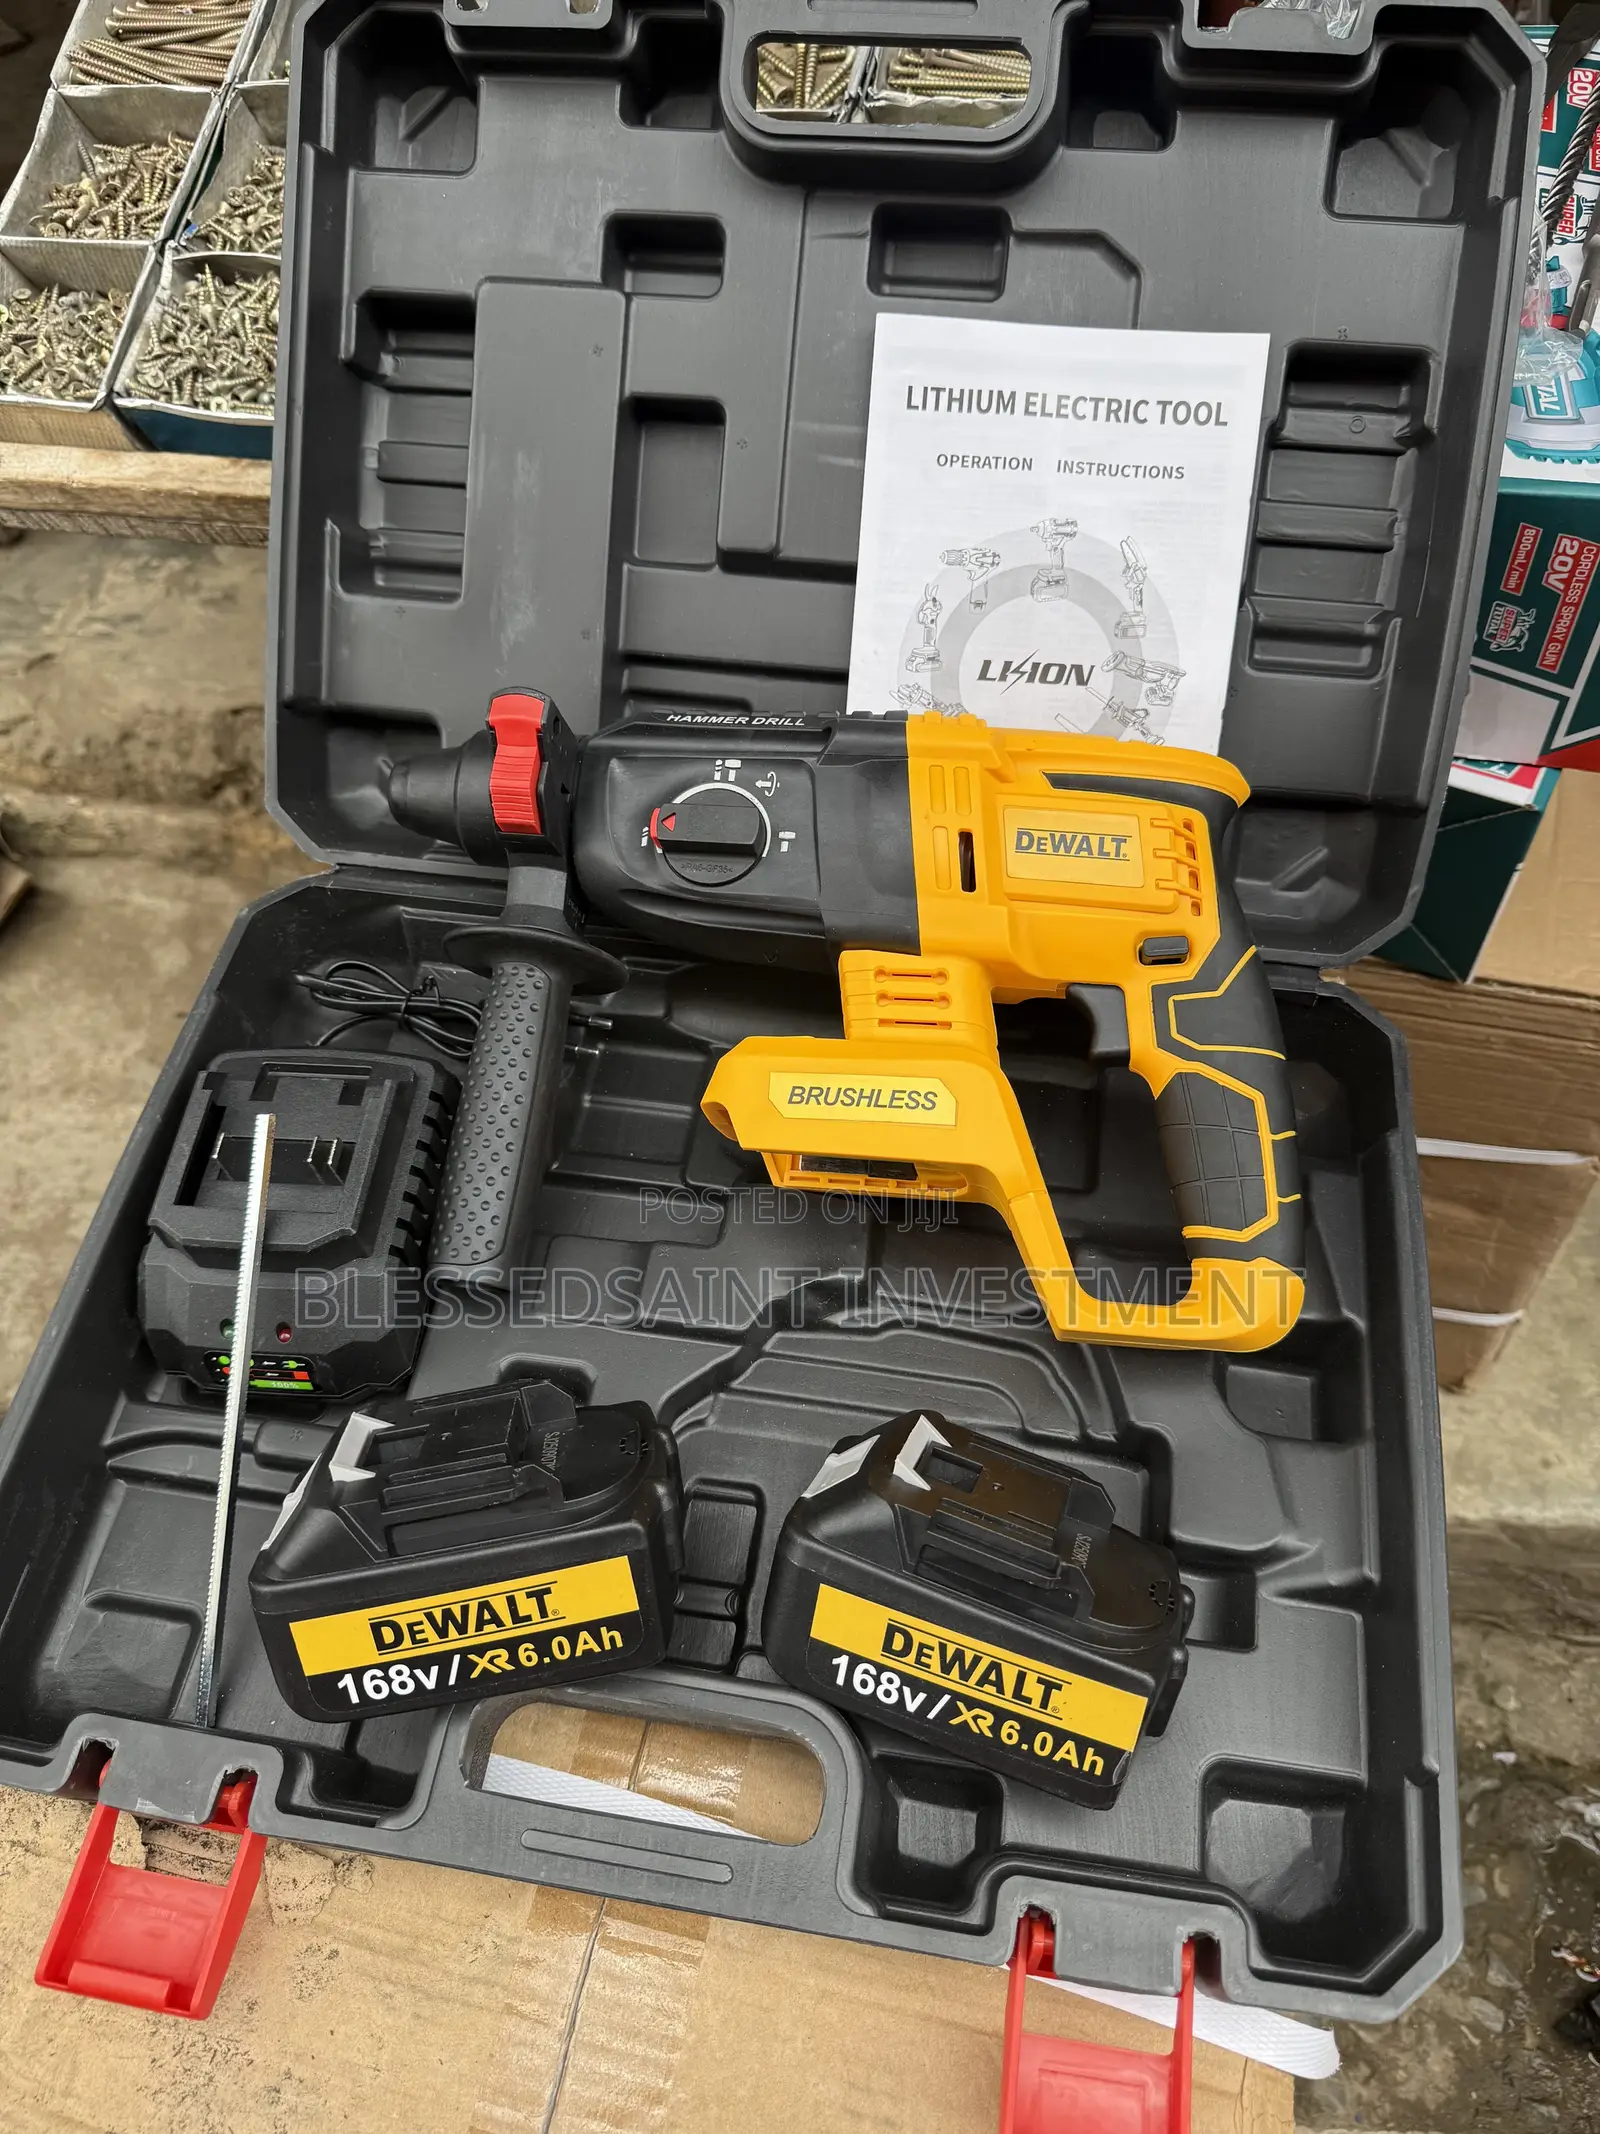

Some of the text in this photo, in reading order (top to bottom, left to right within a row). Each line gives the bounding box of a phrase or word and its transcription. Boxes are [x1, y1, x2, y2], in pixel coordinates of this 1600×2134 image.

[906, 385, 1229, 427] LITHIUM ELECTRIC TOOL
[936, 453, 1186, 480] OPERATION INSTRUCTIONS
[1547, 538, 1580, 590] 20V
[1496, 609, 1516, 641] SUPER
[1543, 545, 1597, 666] CORDLESS SPRAY GUN
[667, 713, 805, 726] HAMMER DRILL
[1015, 829, 1128, 859] DEWALT
[787, 1085, 938, 1111] BRUSHLESS
[369, 1585, 554, 1653] DEWALT
[519, 1628, 624, 1669] 6.0Ah
[881, 1622, 1064, 1712] DEWALT
[999, 1720, 1105, 1777] 6.0Ah
